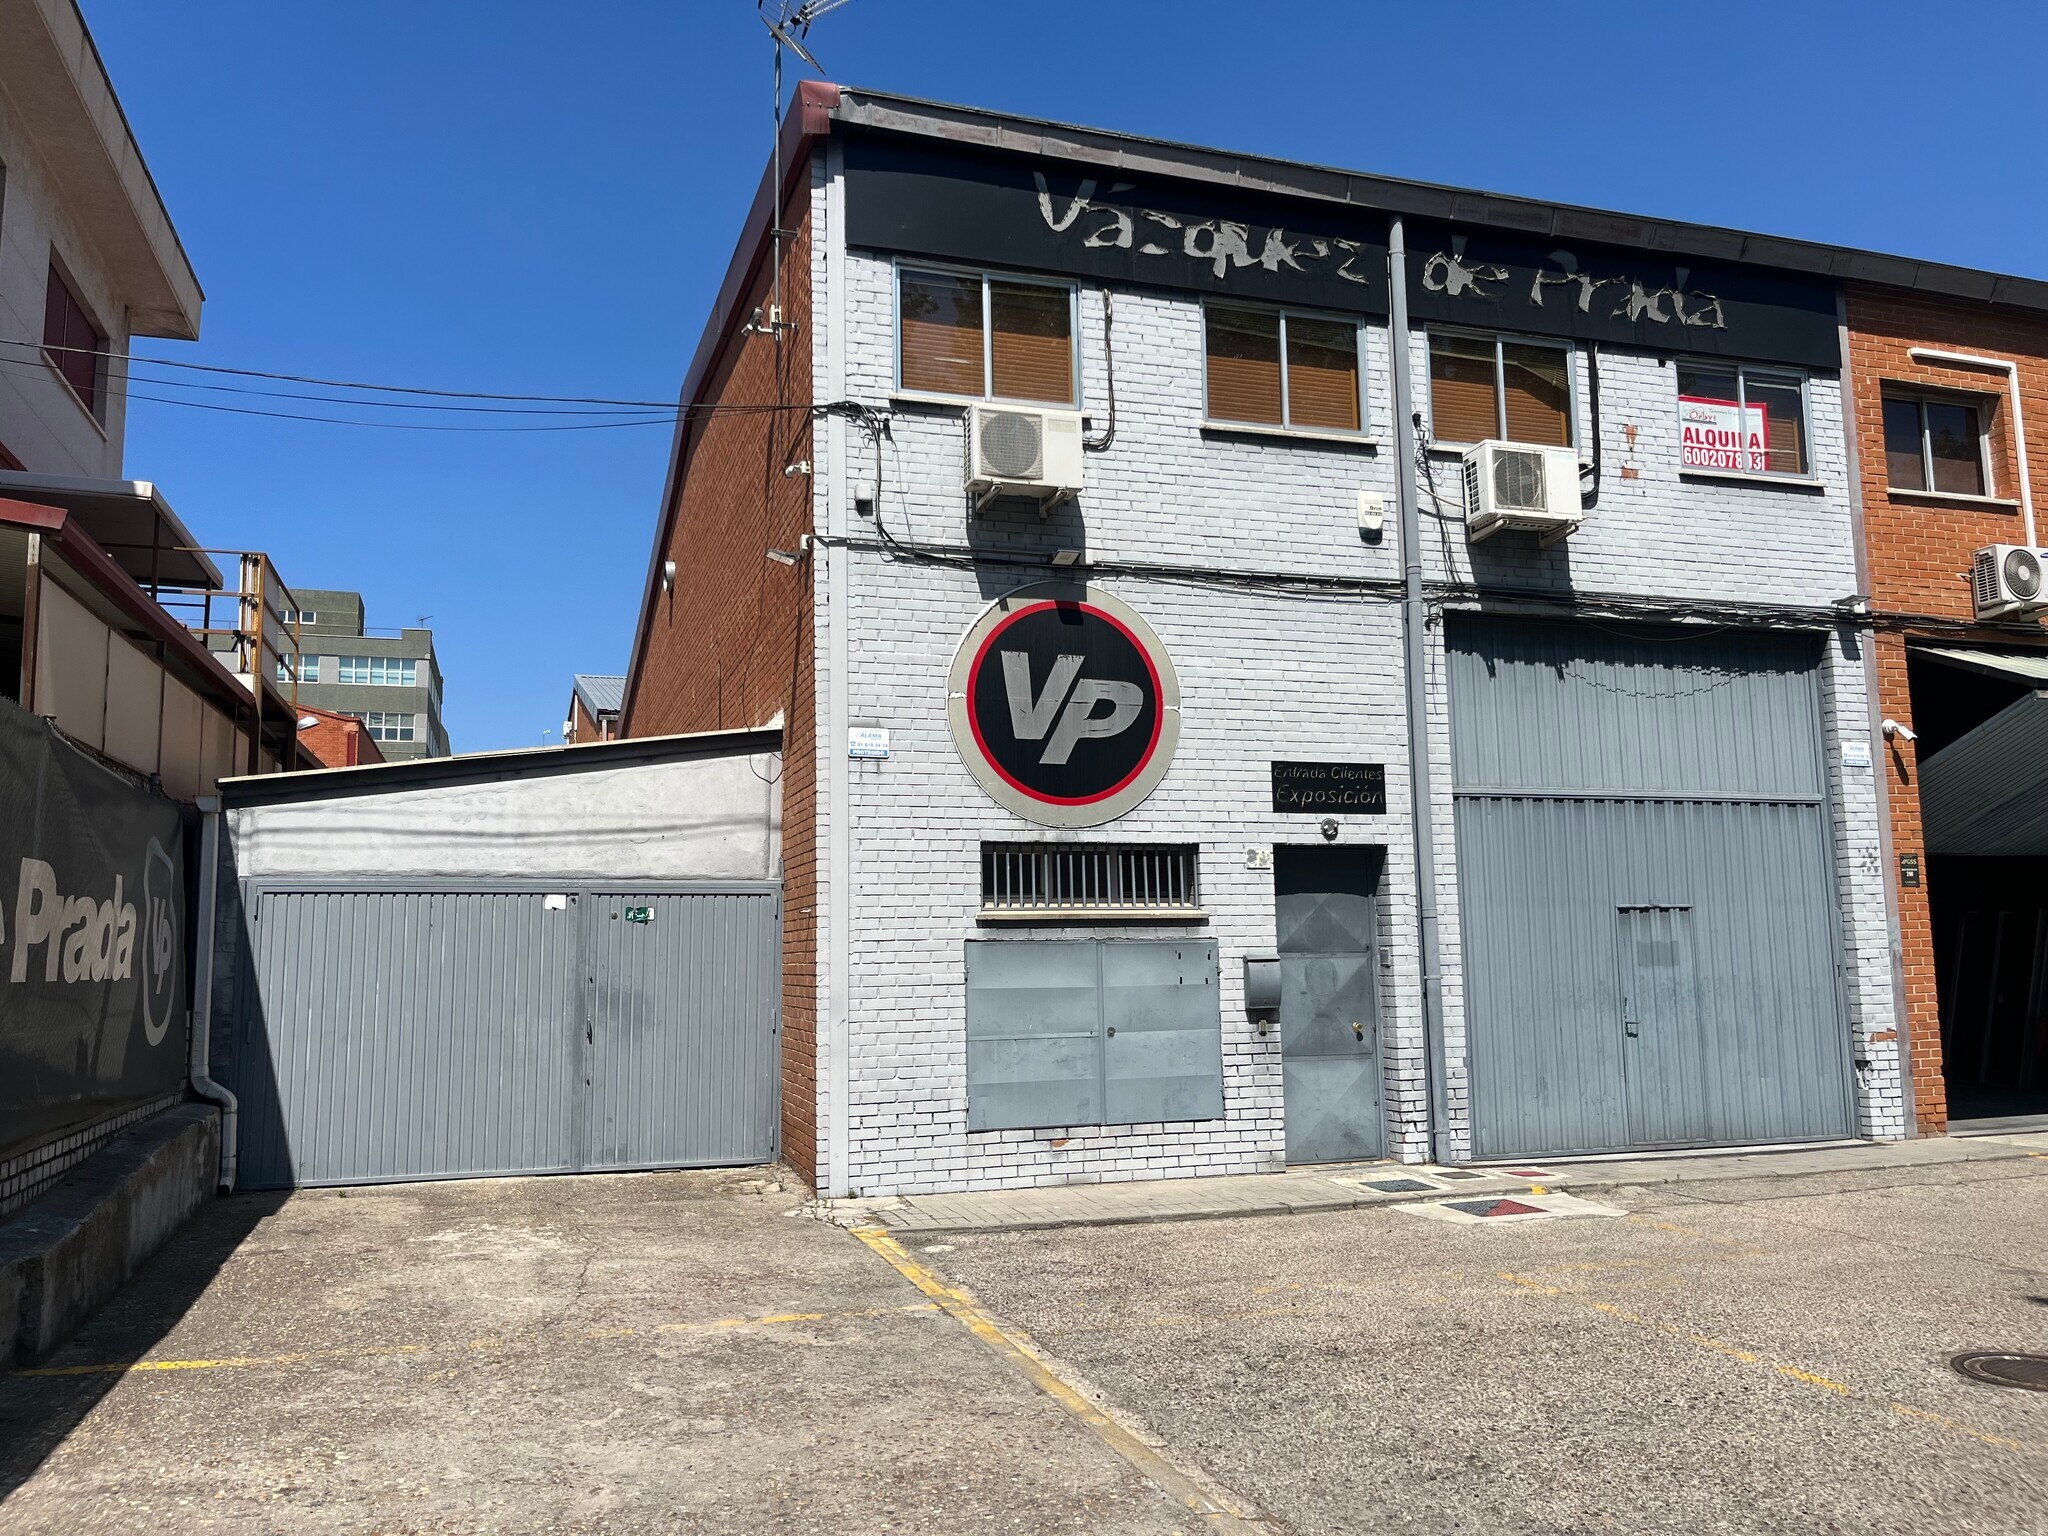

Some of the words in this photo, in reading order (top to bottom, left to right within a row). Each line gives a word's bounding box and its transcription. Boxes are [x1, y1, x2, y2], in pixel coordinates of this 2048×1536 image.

[1000, 650, 1144, 765] VP
[1274, 764, 1326, 779] Entrada
[1331, 766, 1384, 780] Clientes
[1276, 784, 1383, 808] Exposición
[10, 857, 136, 984] Prada
